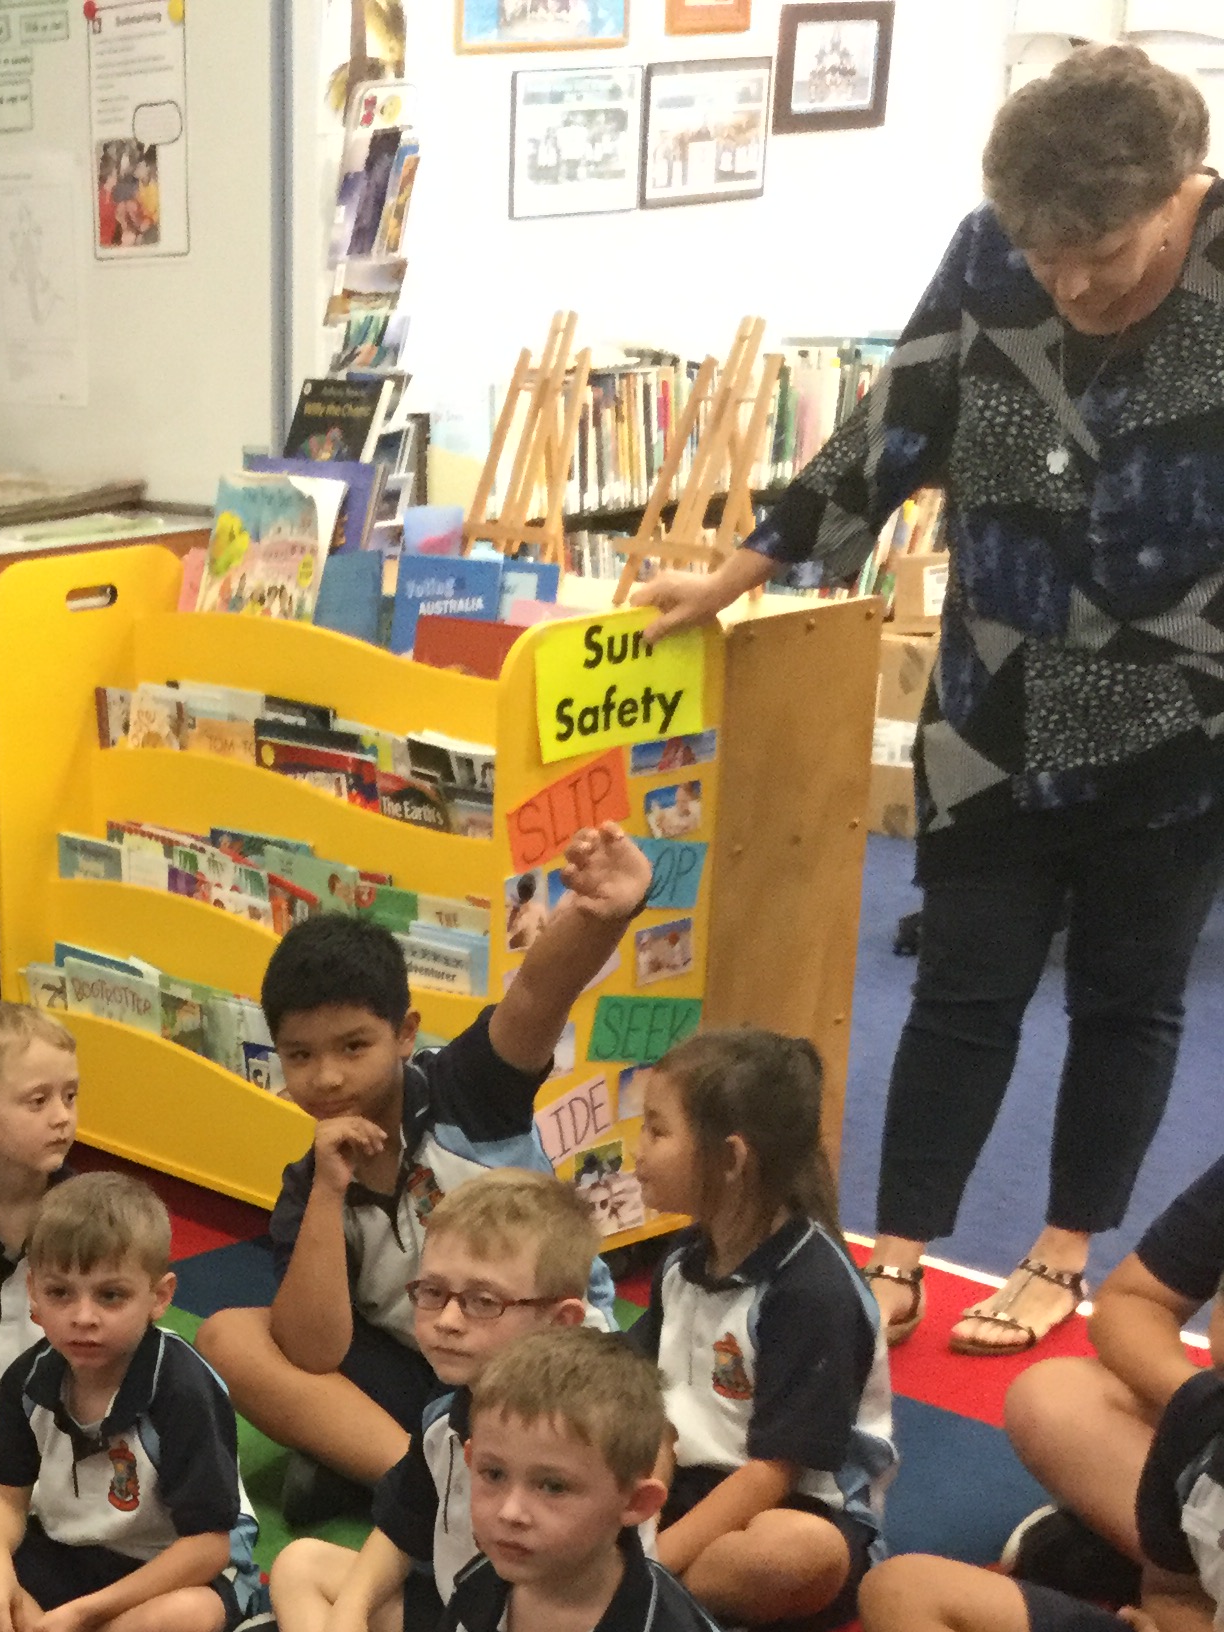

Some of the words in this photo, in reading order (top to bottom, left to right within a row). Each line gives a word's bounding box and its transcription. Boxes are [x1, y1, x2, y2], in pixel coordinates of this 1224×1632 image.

[419, 595, 485, 615] AUSTRALIA
[583, 624, 654, 669] Sun
[555, 684, 685, 742] Safety
[382, 796, 405, 820] The
[517, 765, 612, 865] SLIP
[652, 846, 698, 902] OP
[595, 1002, 694, 1062] SEEK
[550, 1080, 611, 1163] IDE
